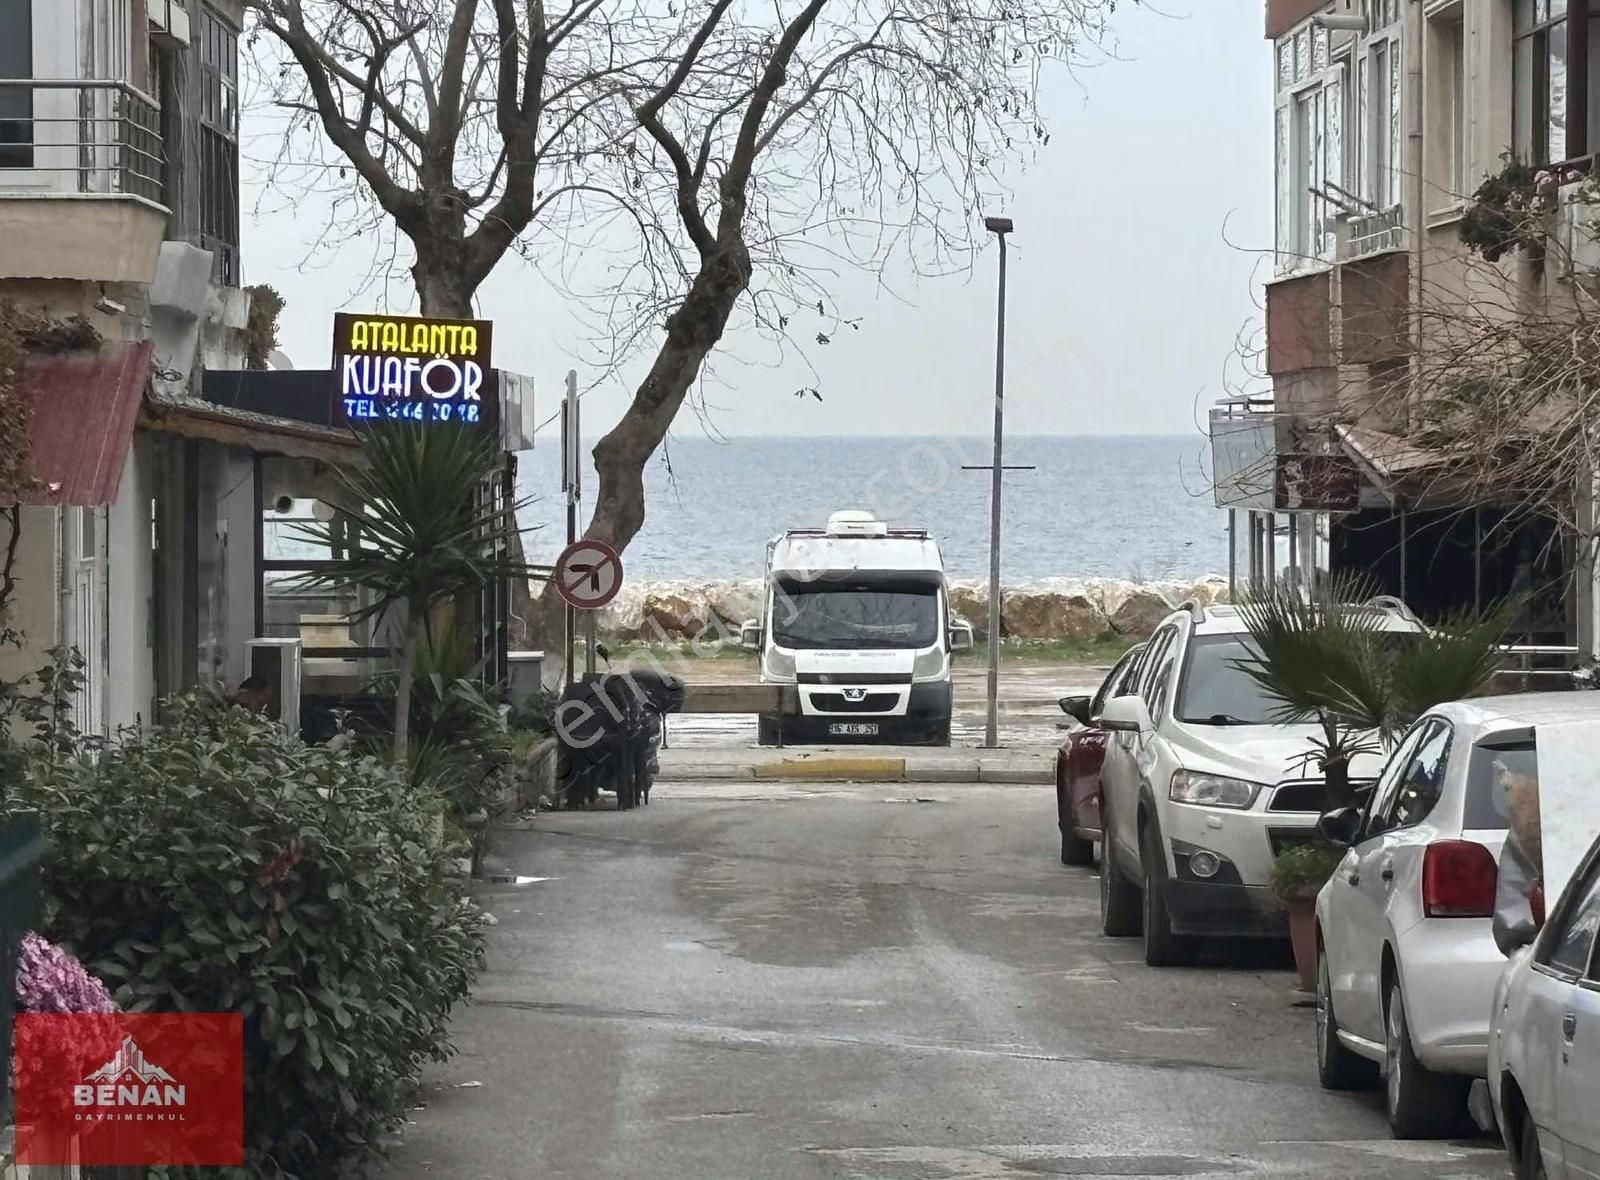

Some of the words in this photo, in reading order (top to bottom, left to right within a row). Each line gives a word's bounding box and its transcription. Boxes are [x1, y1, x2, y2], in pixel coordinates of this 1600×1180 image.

[351, 321, 477, 355] ATALANTA
[342, 352, 483, 401] KUAFÖR
[344, 399, 380, 418] TEL
